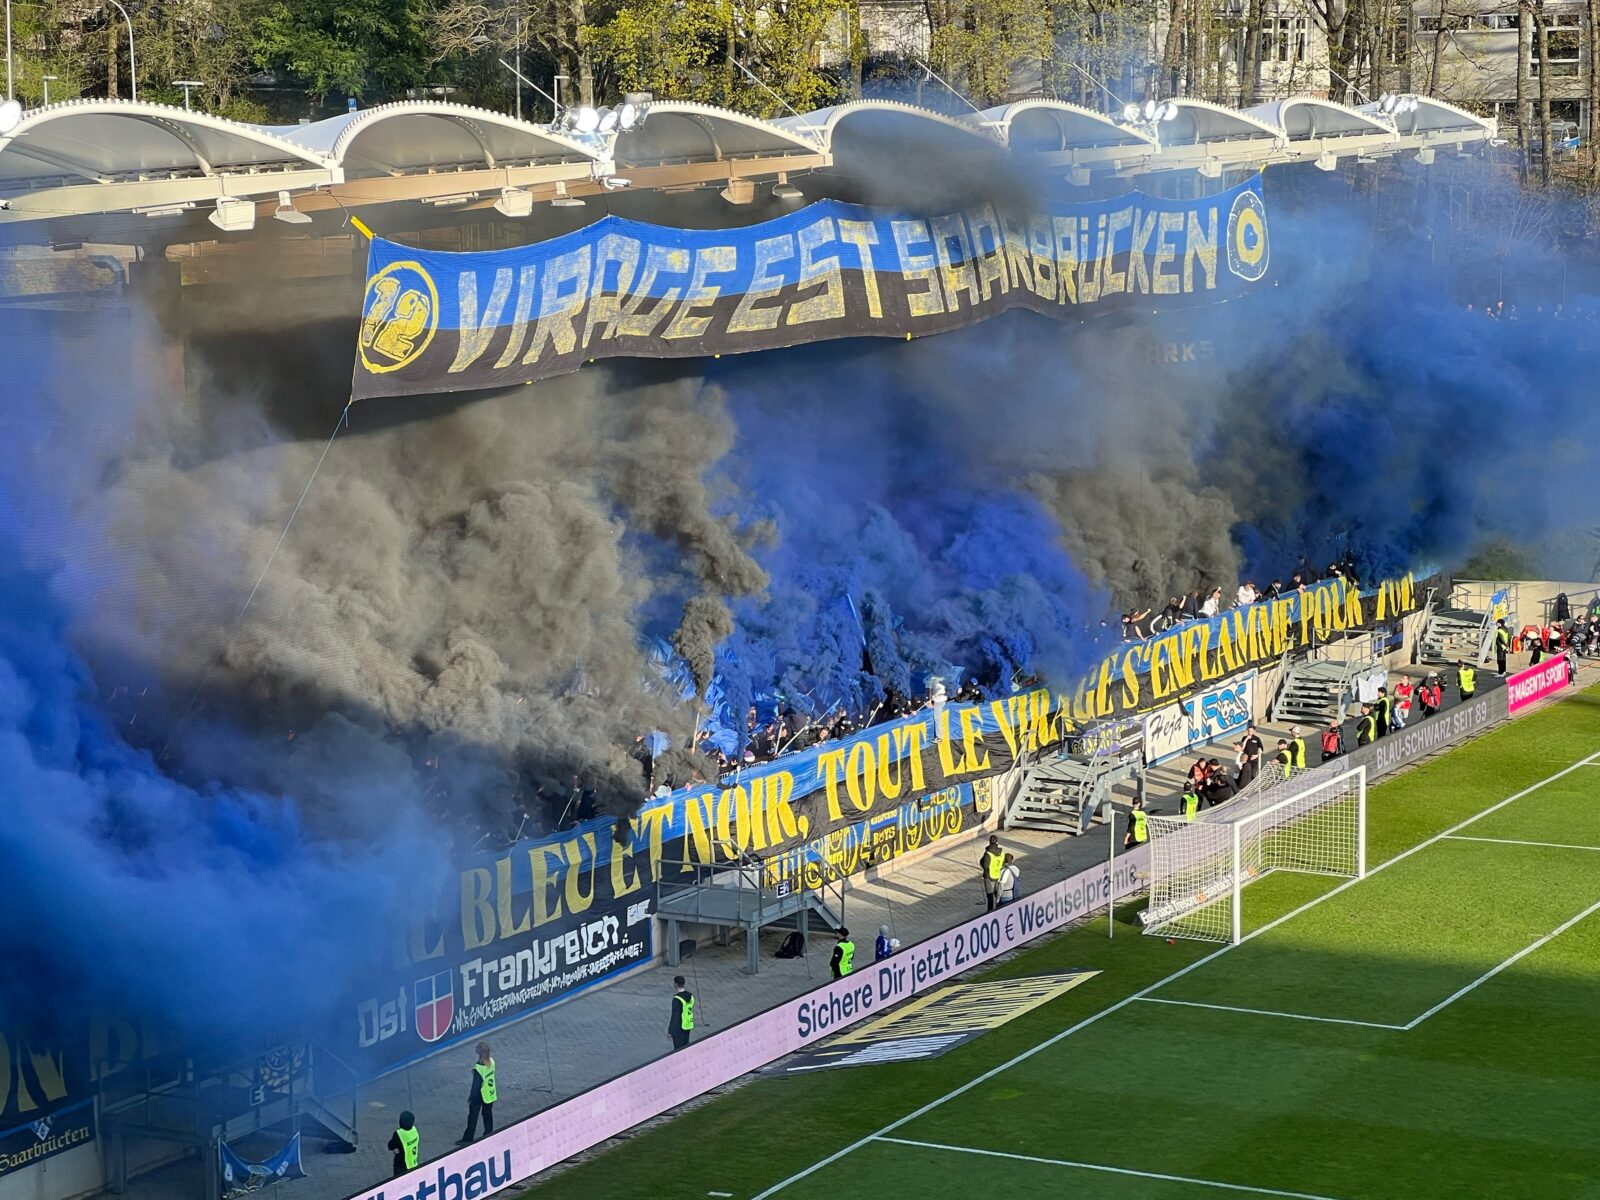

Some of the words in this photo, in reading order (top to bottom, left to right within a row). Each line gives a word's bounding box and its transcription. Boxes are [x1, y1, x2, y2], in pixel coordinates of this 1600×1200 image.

[448, 233, 737, 373] VIRAGE
[726, 217, 883, 333] EST
[890, 203, 1218, 316] SAARBRÜCKEN
[1150, 714, 1183, 744] Heja
[1376, 717, 1450, 770] BLAU-SCHWARZ
[1453, 706, 1474, 732] SEIT
[1475, 701, 1487, 724] 89
[1515, 671, 1546, 703] MAGENTA
[1545, 662, 1566, 688] SPORT
[460, 832, 597, 952] BLEU
[610, 801, 673, 899] ET
[680, 770, 809, 873] NOIR,
[817, 721, 927, 821] TOUT
[938, 706, 991, 778] LE
[357, 986, 407, 1048] Ost
[460, 912, 619, 1007] Frankreich
[797, 984, 873, 1039] Sichere
[879, 962, 906, 1001] Dir
[910, 942, 950, 995] jetzt
[953, 917, 1000, 967] 2.000
[1005, 913, 1015, 942] €
[1019, 860, 1138, 936] Wechselprämie
